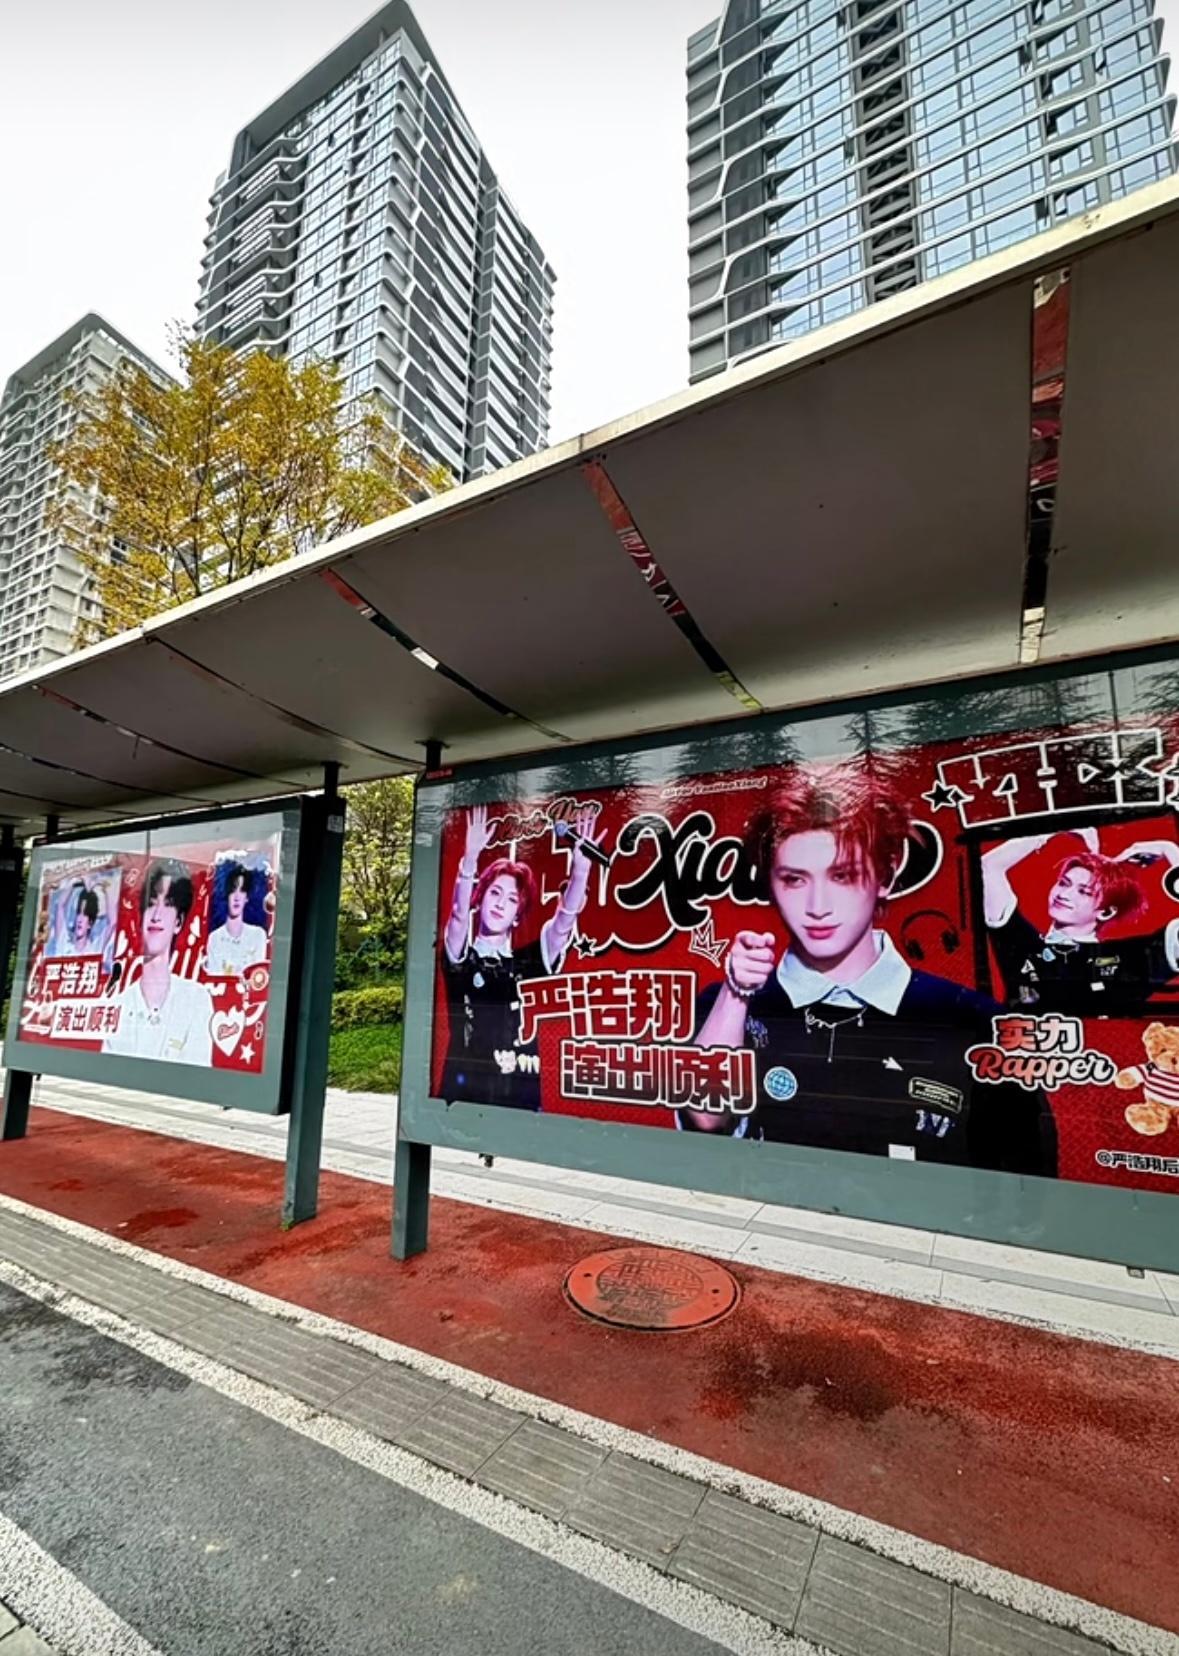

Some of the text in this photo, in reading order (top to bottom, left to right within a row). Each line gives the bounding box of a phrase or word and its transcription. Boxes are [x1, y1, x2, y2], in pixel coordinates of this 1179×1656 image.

[43, 961, 100, 995] 严浩翔
[55, 1004, 122, 1034] 演出顺利
[518, 971, 696, 1043] 严浩翔
[995, 1016, 1081, 1052] 实力
[561, 1042, 756, 1114] 演出顺利
[967, 1046, 1115, 1089] Rapper
